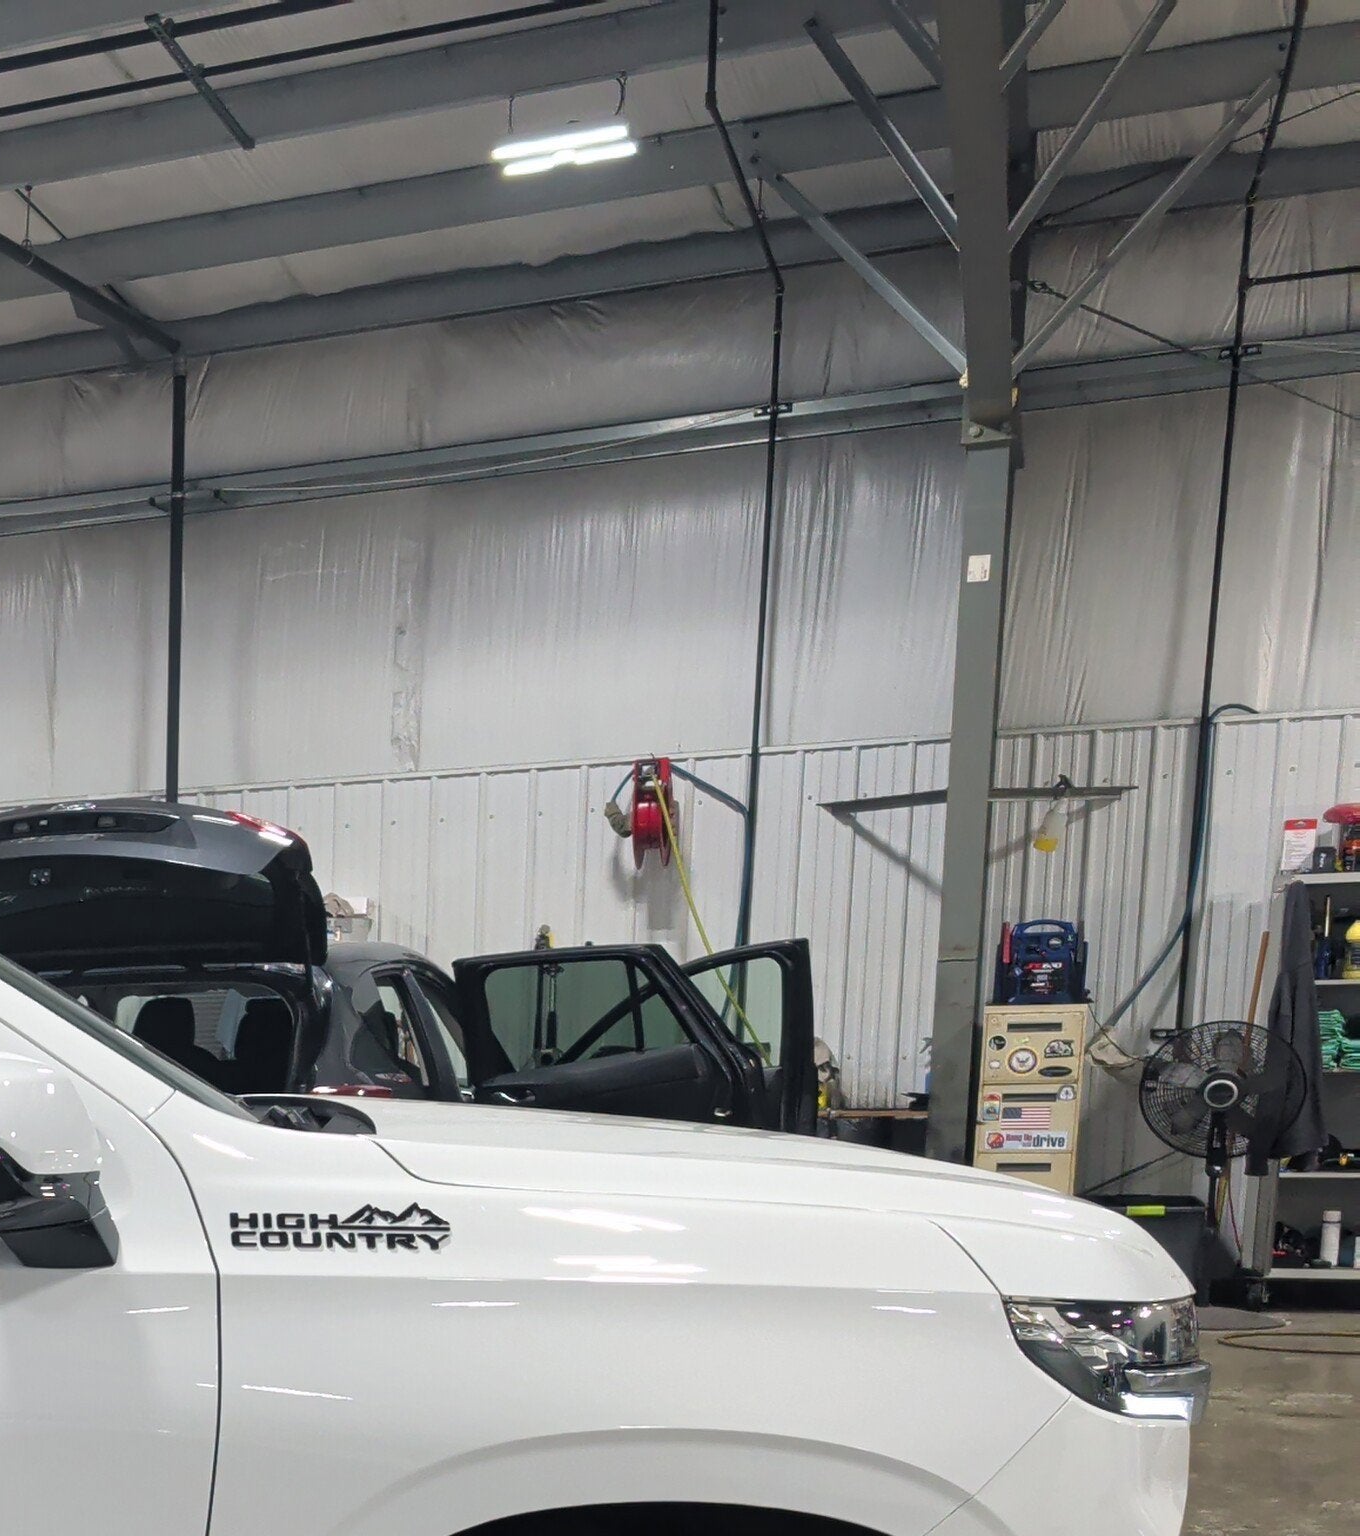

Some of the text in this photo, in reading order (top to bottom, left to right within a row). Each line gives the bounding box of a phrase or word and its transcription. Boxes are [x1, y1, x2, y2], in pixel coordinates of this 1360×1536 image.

[1032, 1134, 1066, 1148] drive
[229, 1212, 338, 1230] HIGH
[230, 1230, 450, 1251] COUNTRY
